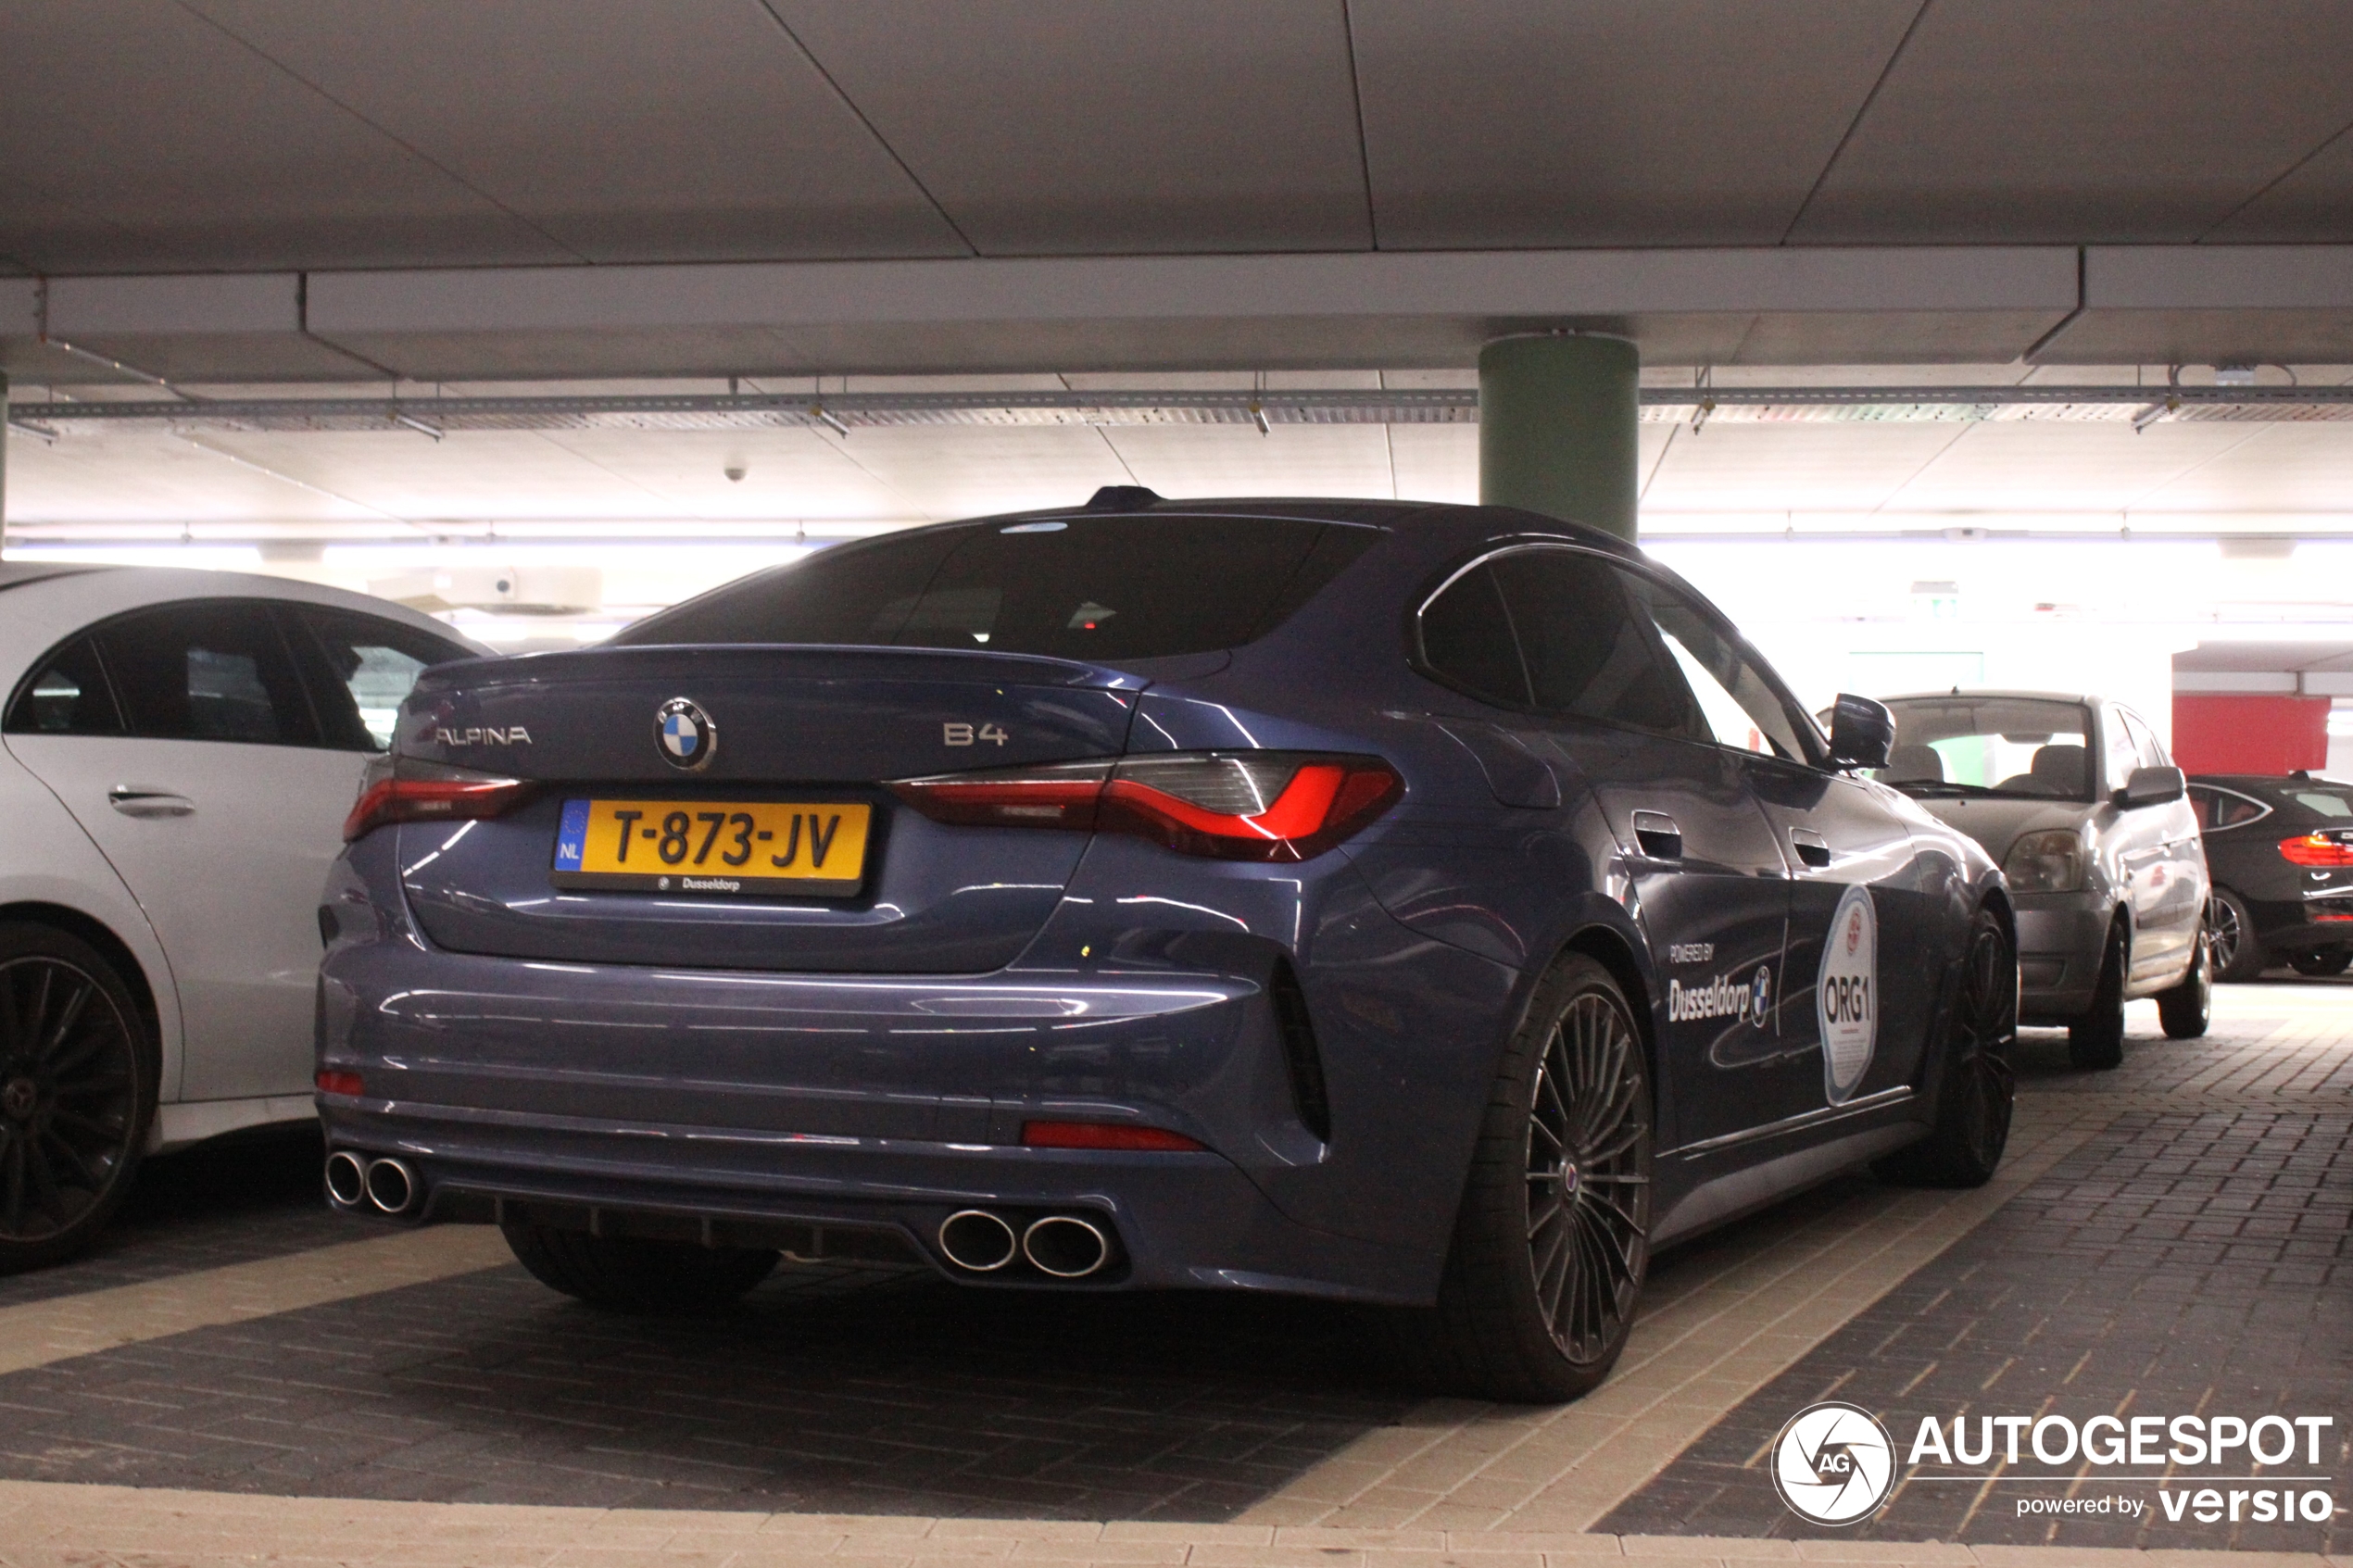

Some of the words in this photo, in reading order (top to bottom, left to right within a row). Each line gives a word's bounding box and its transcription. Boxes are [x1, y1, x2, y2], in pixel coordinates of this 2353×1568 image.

[435, 726, 534, 746] ALPINA
[943, 722, 1010, 746] B4
[613, 809, 841, 869] T-873-JV
[560, 842, 580, 860] NL
[682, 876, 741, 892] Dusseldorp
[1670, 944, 1704, 963] POWERED
[1668, 974, 1751, 1022] Dusseldorp
[1824, 975, 1871, 1024] ORG1
